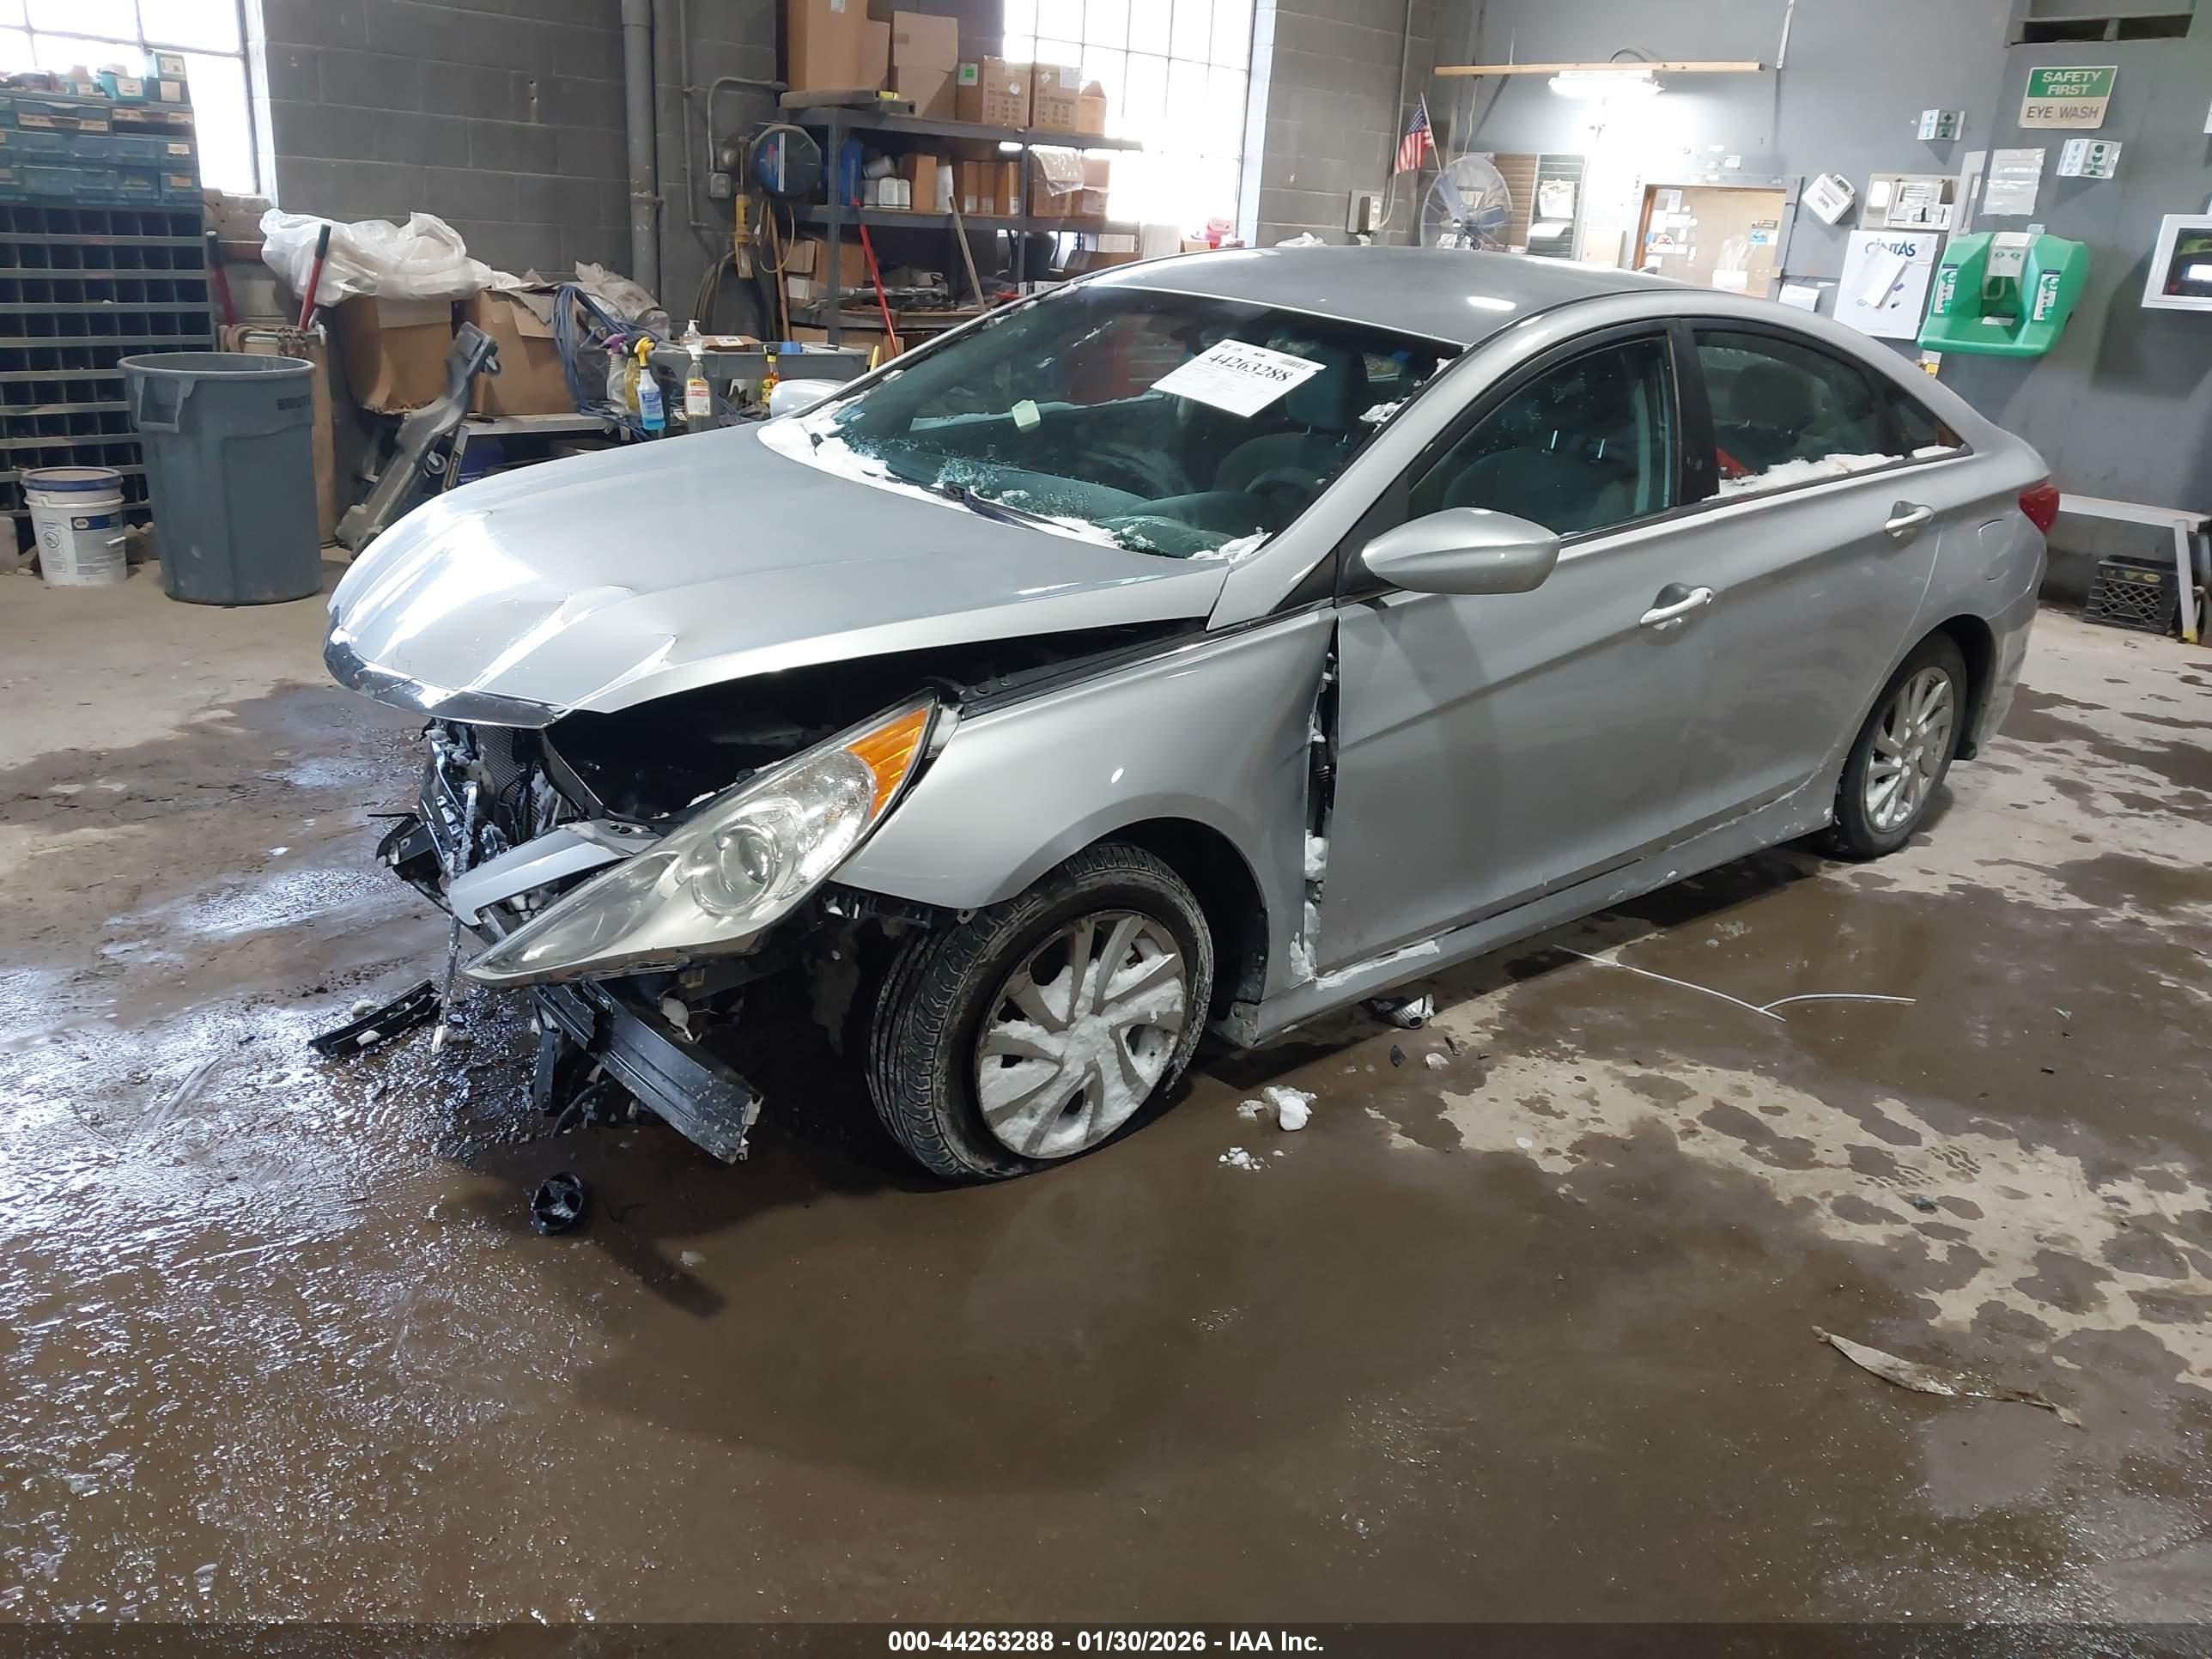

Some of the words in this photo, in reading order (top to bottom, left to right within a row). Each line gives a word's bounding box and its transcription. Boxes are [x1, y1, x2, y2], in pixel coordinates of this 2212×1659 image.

[2041, 71, 2103, 82] SAFETY
[2047, 84, 2091, 95] FIRST
[2027, 106, 2054, 118] EYE
[2059, 106, 2100, 118] WASH
[1208, 353, 1294, 382] 44263288
